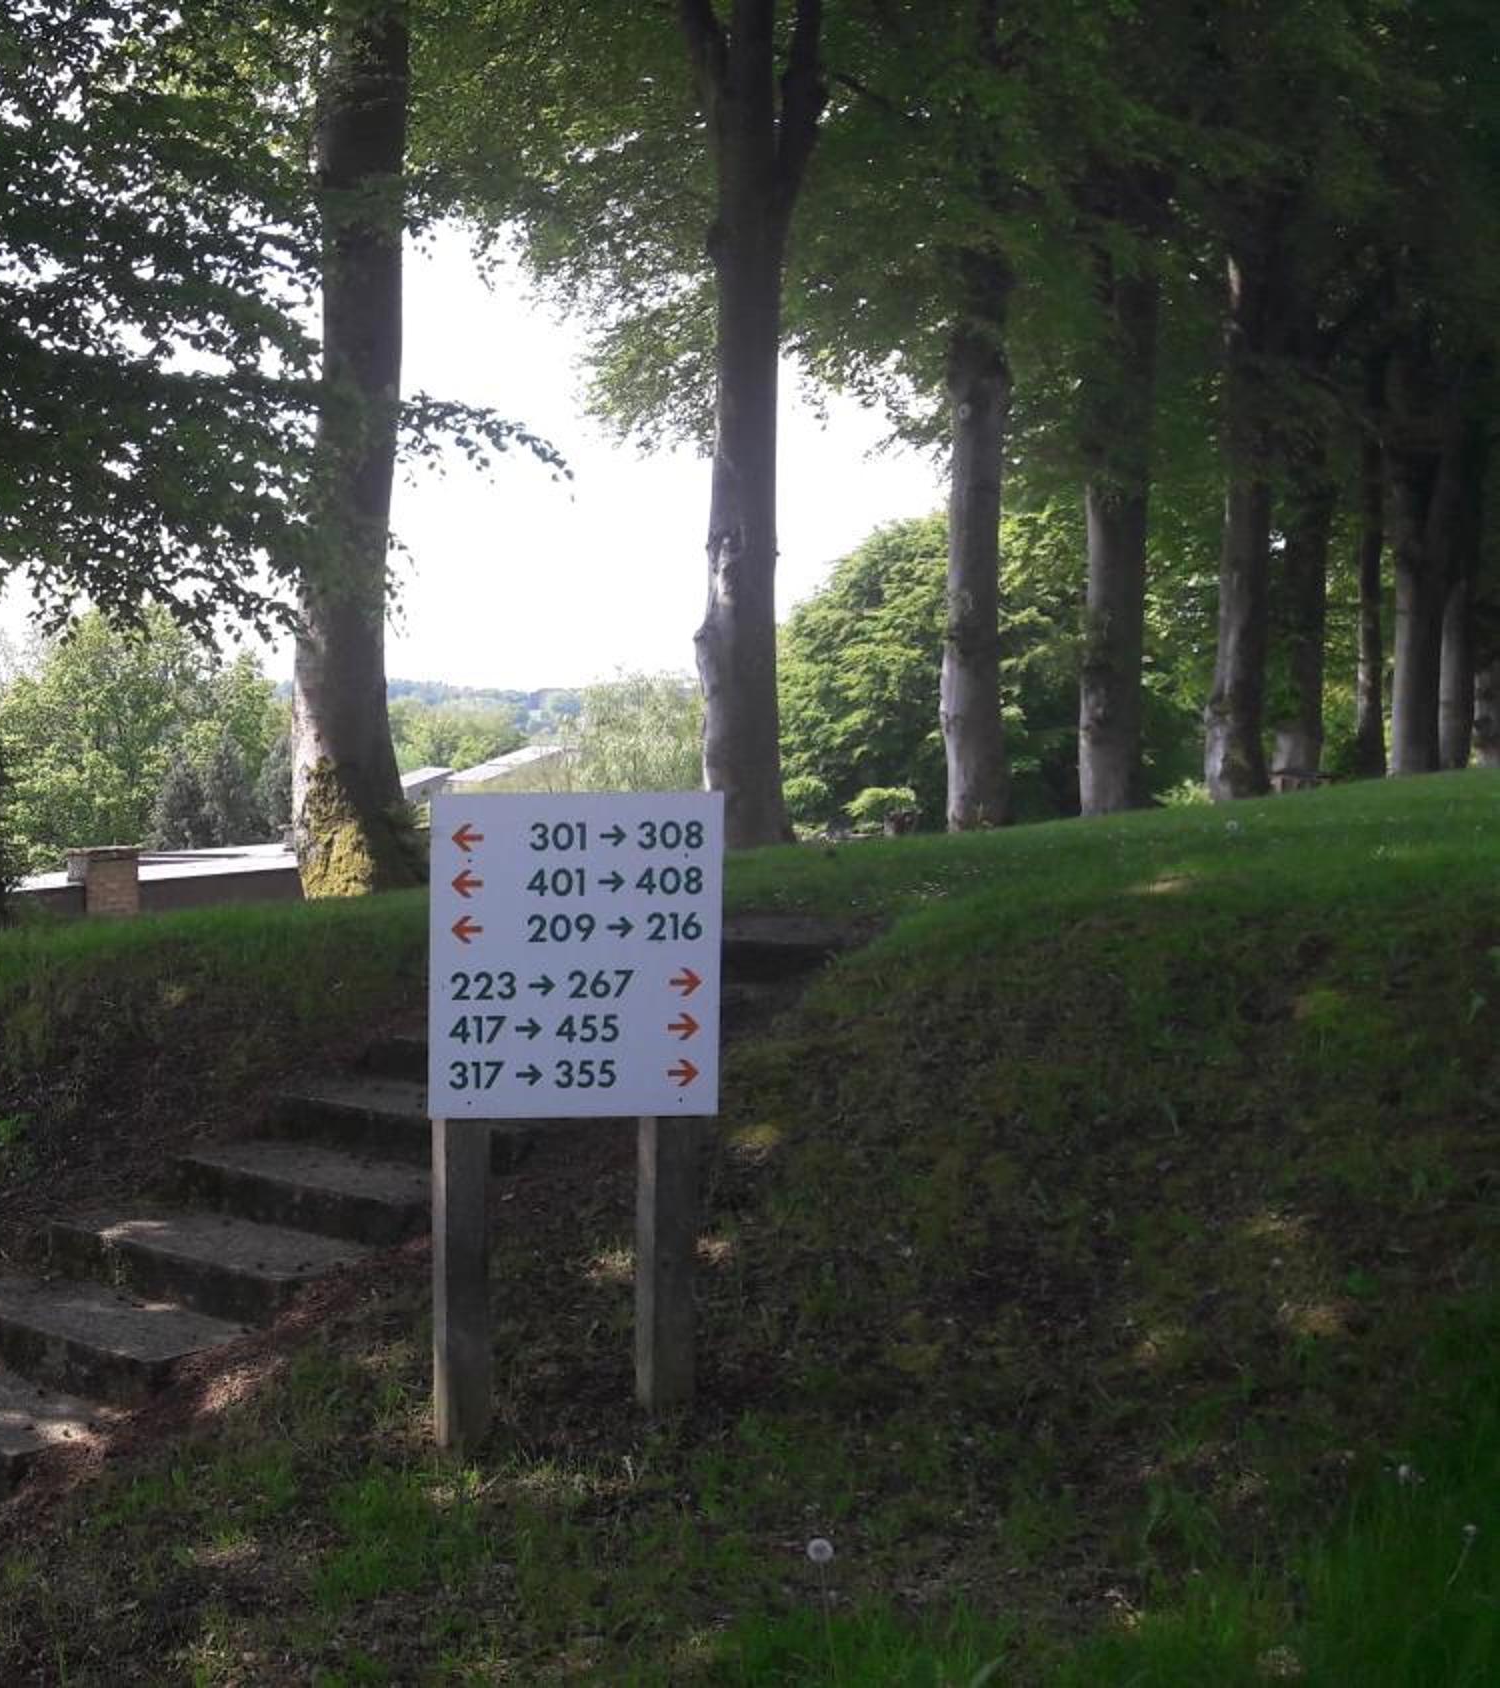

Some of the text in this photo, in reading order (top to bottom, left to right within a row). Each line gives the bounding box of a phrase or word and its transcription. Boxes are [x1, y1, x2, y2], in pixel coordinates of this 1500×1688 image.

[530, 821, 704, 851] 301 308
[527, 867, 703, 896] 401 408
[527, 912, 702, 942] 209 216
[451, 969, 634, 1000] 223 267
[449, 1014, 619, 1044] 417 455
[449, 1060, 617, 1090] 317 355
